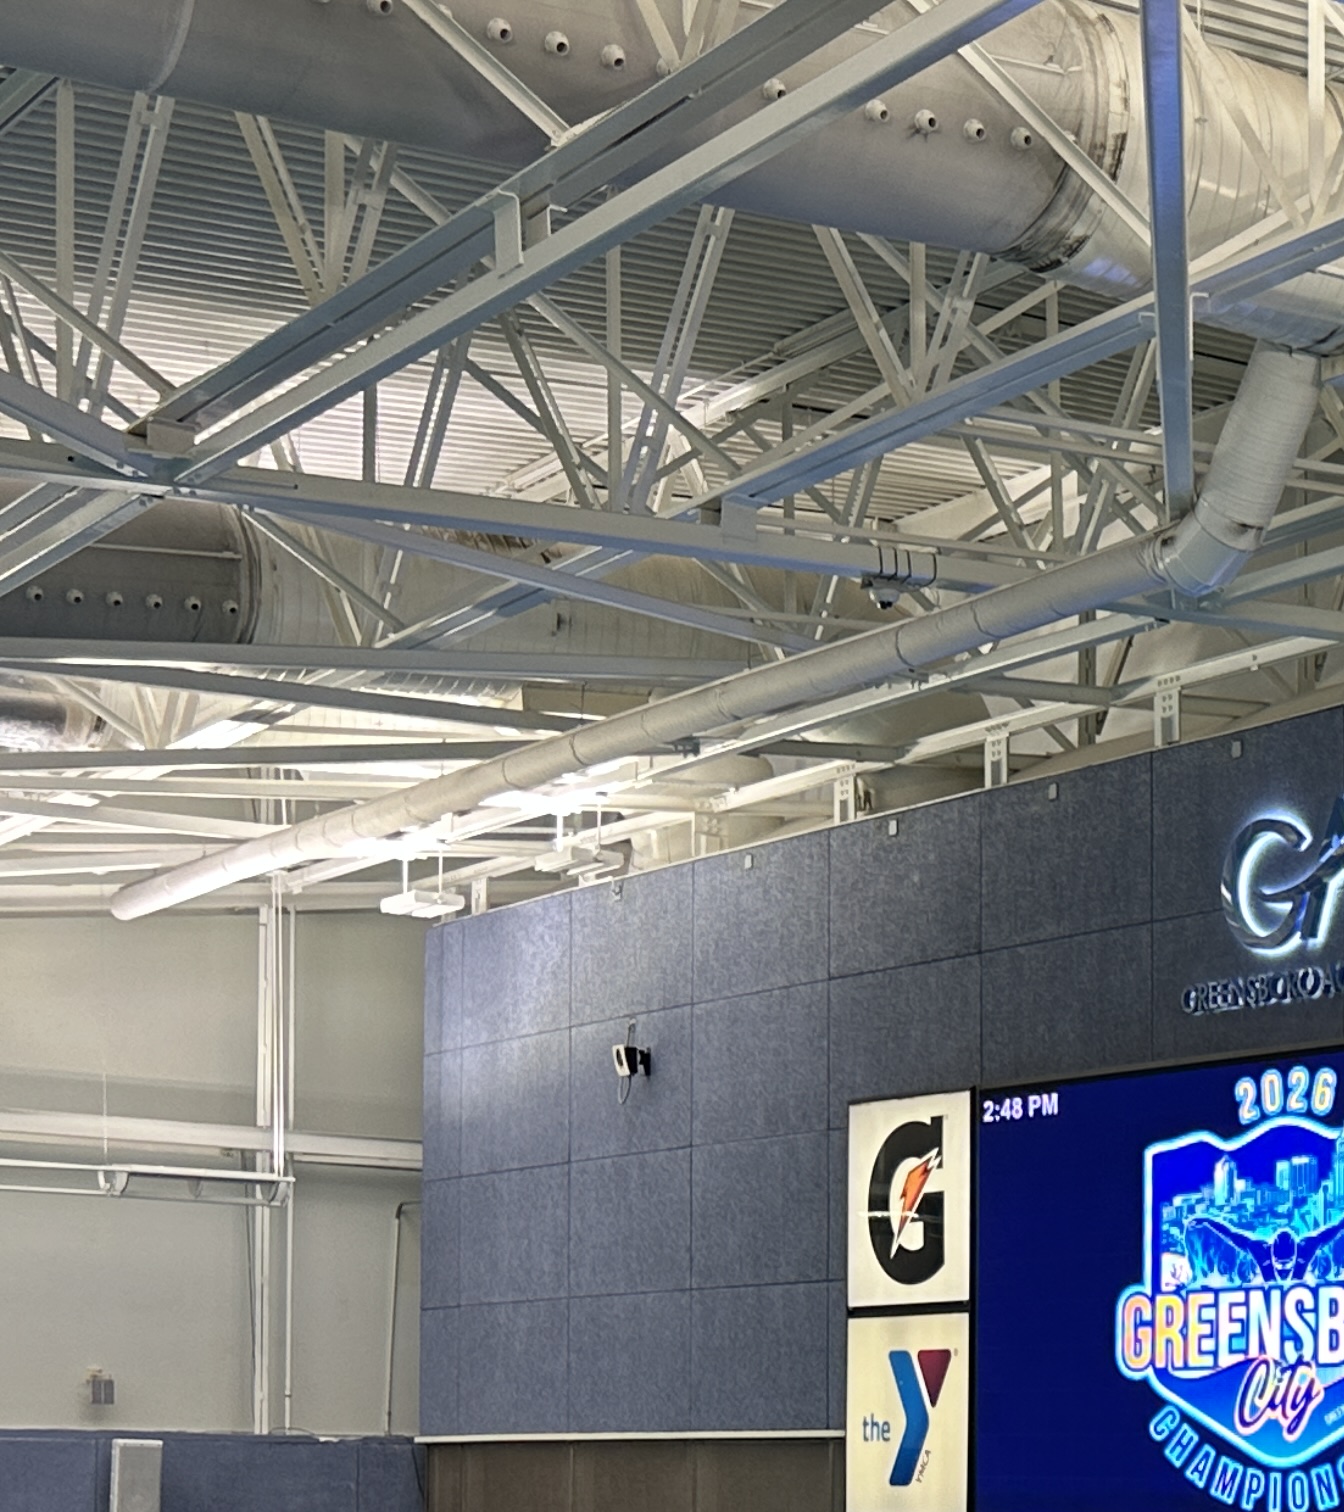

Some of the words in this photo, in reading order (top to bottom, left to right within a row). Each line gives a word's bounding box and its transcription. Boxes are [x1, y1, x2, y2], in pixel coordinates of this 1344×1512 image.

[1180, 965, 1325, 1016] GREENSBORO
[982, 1097, 1023, 1123] 2:48
[1027, 1092, 1059, 1117] PM
[1235, 1066, 1337, 1125] 2026
[1235, 1355, 1324, 1441] City
[862, 1413, 891, 1442] the
